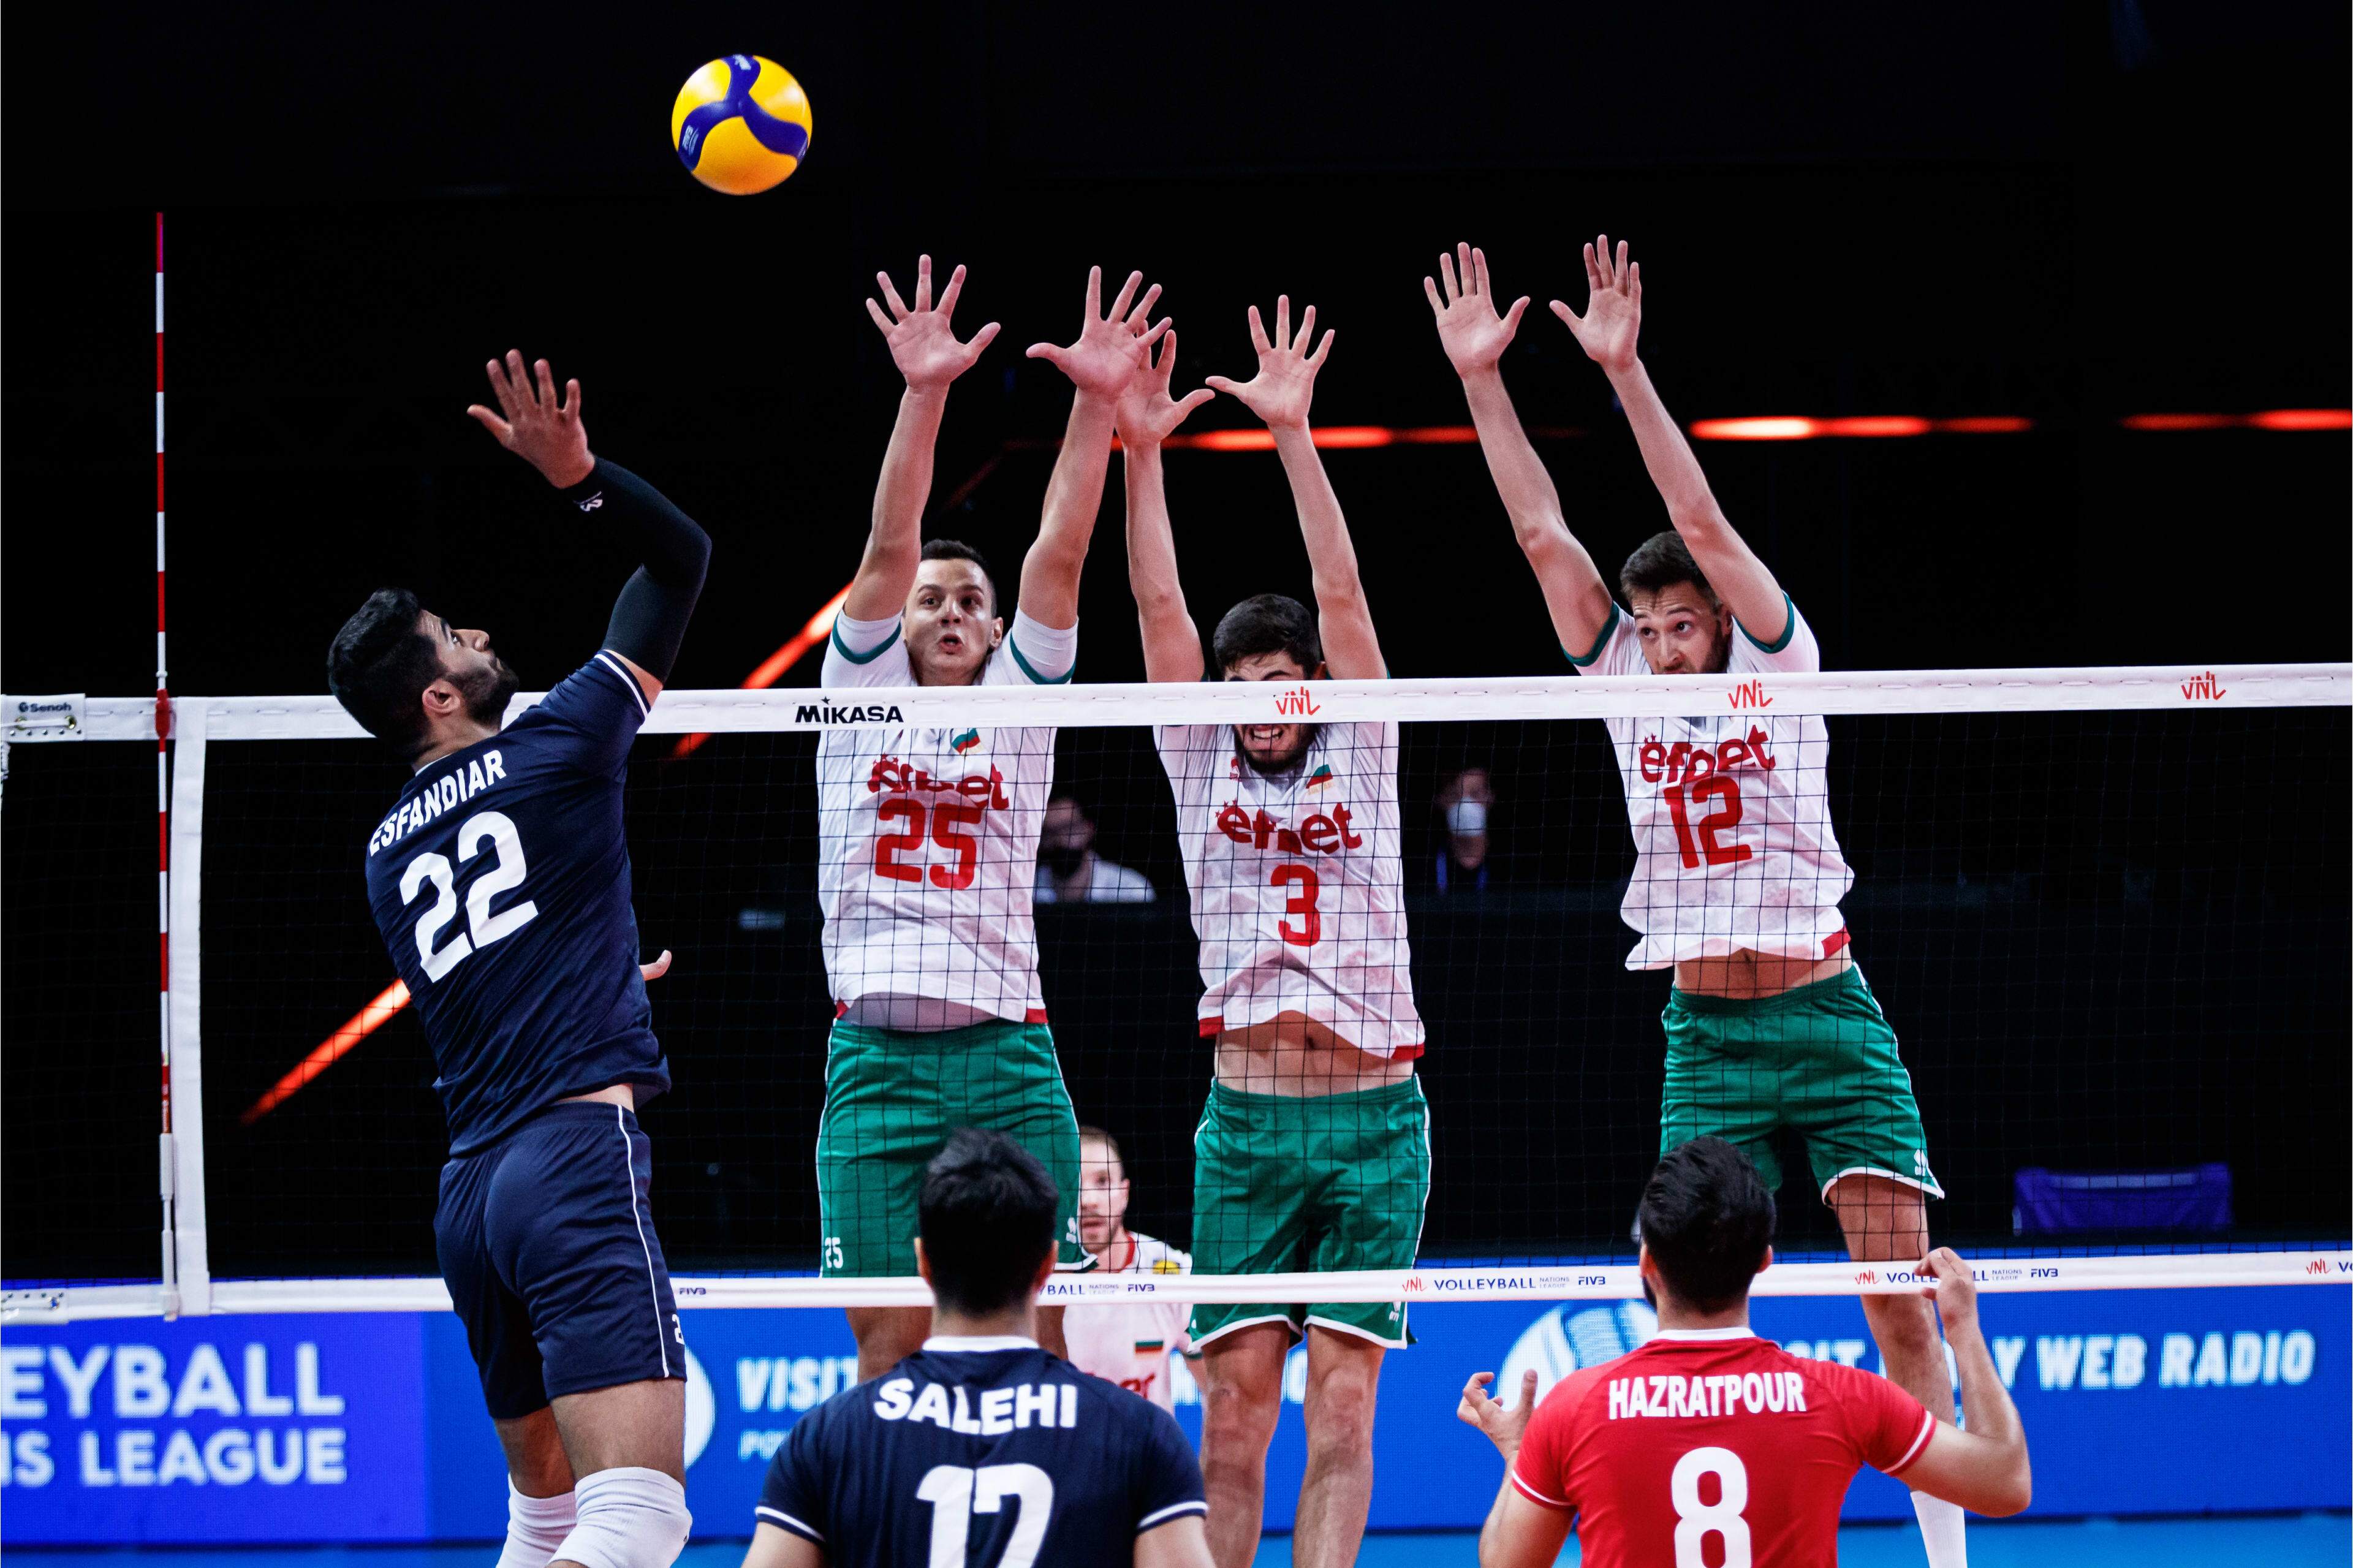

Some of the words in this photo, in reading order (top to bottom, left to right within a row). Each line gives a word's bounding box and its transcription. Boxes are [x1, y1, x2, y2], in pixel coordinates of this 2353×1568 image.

[1276, 686, 1320, 715] VNL
[1729, 679, 1773, 708] VNL
[2181, 671, 2226, 700] VNL
[30, 702, 72, 712] Senoh
[795, 705, 904, 724] MIKASA
[369, 749, 506, 857] ESFANDIAR
[1663, 776, 1752, 869] 12
[875, 798, 983, 890] 25
[399, 811, 538, 983] 22
[1271, 864, 1320, 947] 3
[824, 1237, 844, 1269] 25
[2306, 1257, 2331, 1274] VNL
[1127, 1284, 1155, 1292] FIVB
[1403, 1276, 1428, 1292] VNL
[1434, 1278, 1537, 1290] VOLLEYBALL
[1578, 1276, 1605, 1286] FIVB
[1855, 1269, 1880, 1284] VNL
[2031, 1268, 2058, 1278] FIVB
[2036, 1333, 2148, 1391] WEB
[2159, 1328, 2316, 1389] RADIO
[874, 1378, 1077, 1436] SALEHI
[1608, 1372, 1806, 1420] HAZRATPOUR
[78, 1428, 347, 1487] LEAGUE
[917, 1463, 1054, 1568] 17
[1671, 1447, 1752, 1568] 8
